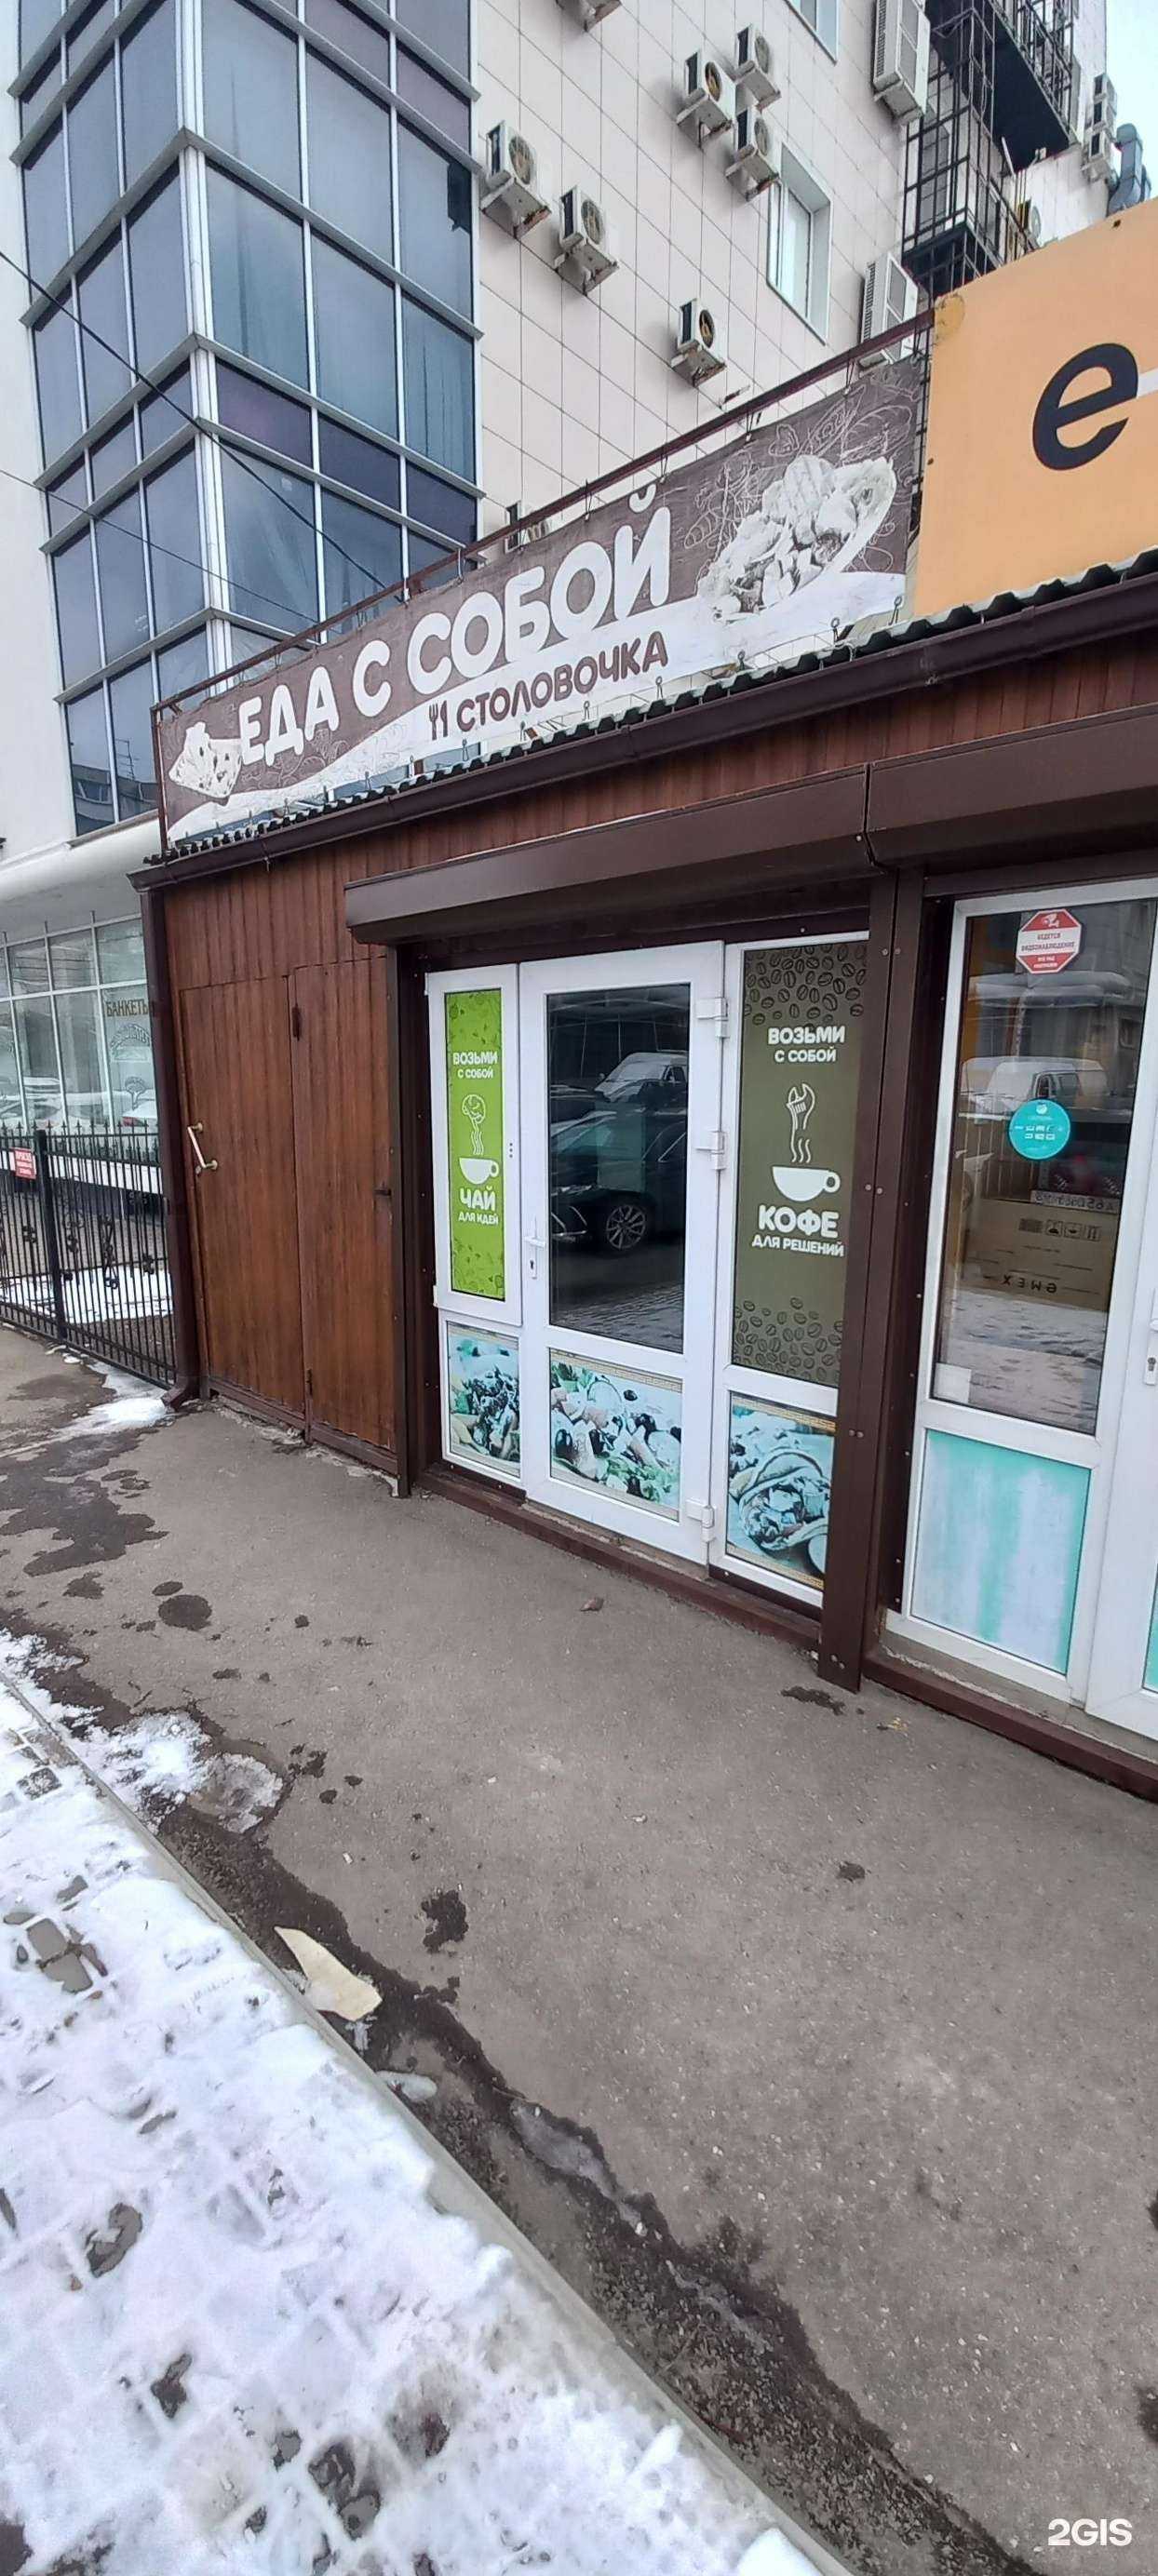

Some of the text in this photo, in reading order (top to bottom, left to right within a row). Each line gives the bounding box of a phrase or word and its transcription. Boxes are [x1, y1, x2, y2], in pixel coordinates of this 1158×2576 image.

[239, 483, 671, 767] ЕДА С СОБОЙ
[456, 630, 668, 732] СТОЛОВОЧКА
[768, 1026, 845, 1044] ВОЗЬМИ
[452, 1051, 498, 1066] ВОЗЬМИ
[774, 1045, 837, 1063] С СОБОЙ
[457, 1066, 493, 1080] С СОБОЙ
[459, 1185, 496, 1212] ЧАЙ
[458, 1211, 499, 1226] ДЛЯ ИДЕЙ
[758, 1204, 840, 1239] КОФЕ
[751, 1234, 844, 1257] ДЛЯ РЕШЕНИЙ
